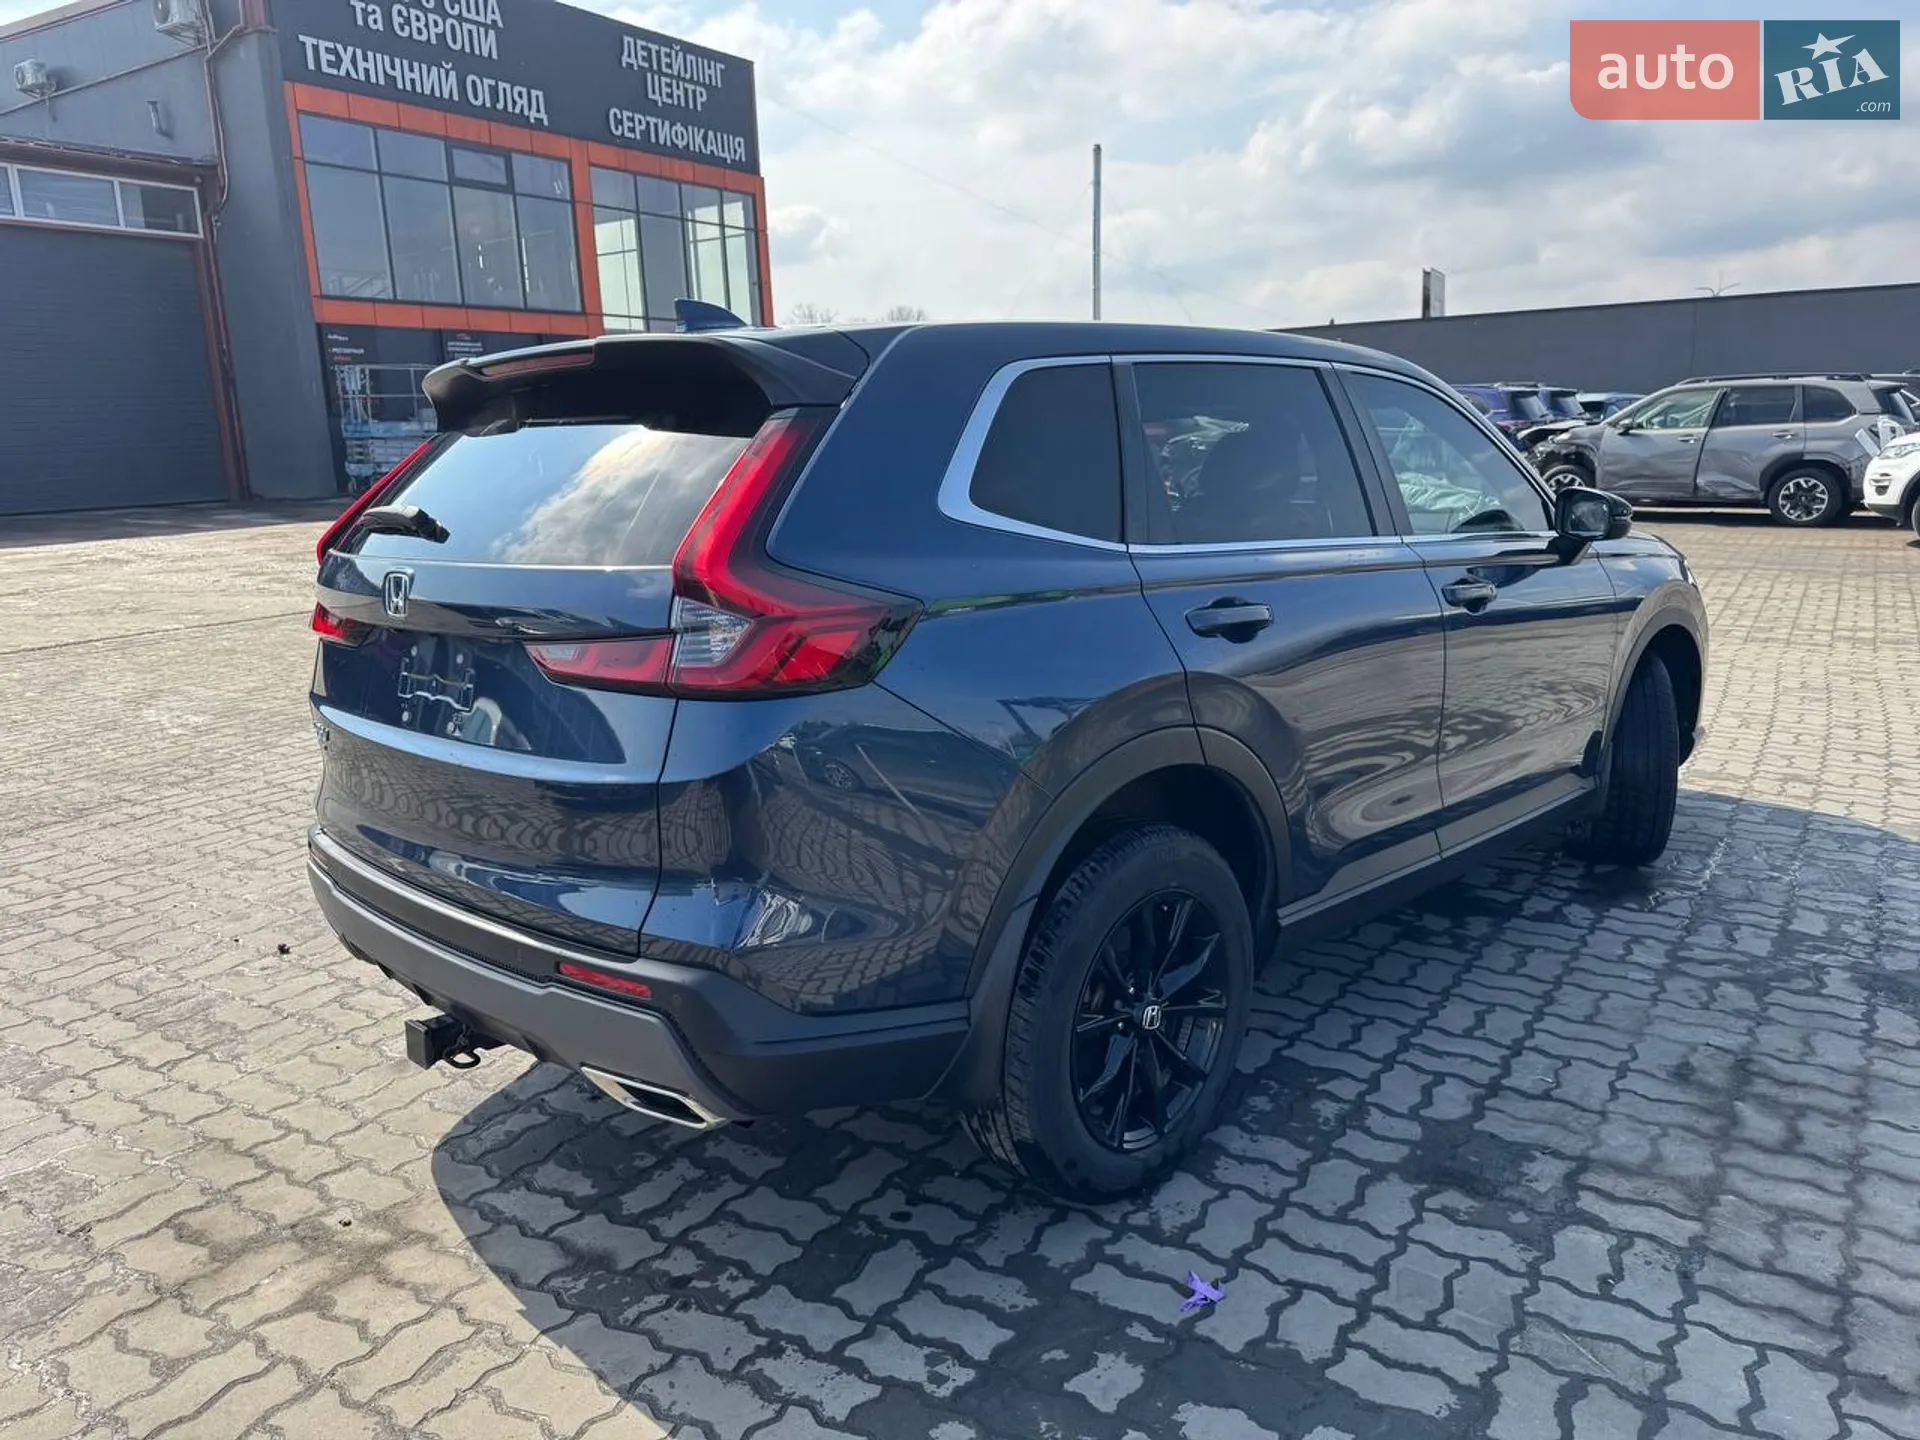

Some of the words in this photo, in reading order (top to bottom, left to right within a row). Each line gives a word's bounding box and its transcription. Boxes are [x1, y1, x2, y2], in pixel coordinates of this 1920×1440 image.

[351, 0, 384, 31] та
[391, 4, 497, 60] ЄВРОПИ
[298, 34, 459, 101] ТЕХНІЧНИЙ
[466, 74, 549, 126] ОГЛЯД
[621, 35, 725, 88] ДЕТЕЙЛІНГ
[646, 72, 707, 111] ЦЕНТР
[609, 107, 746, 164] СЕРТИФІКАЦІЯ
